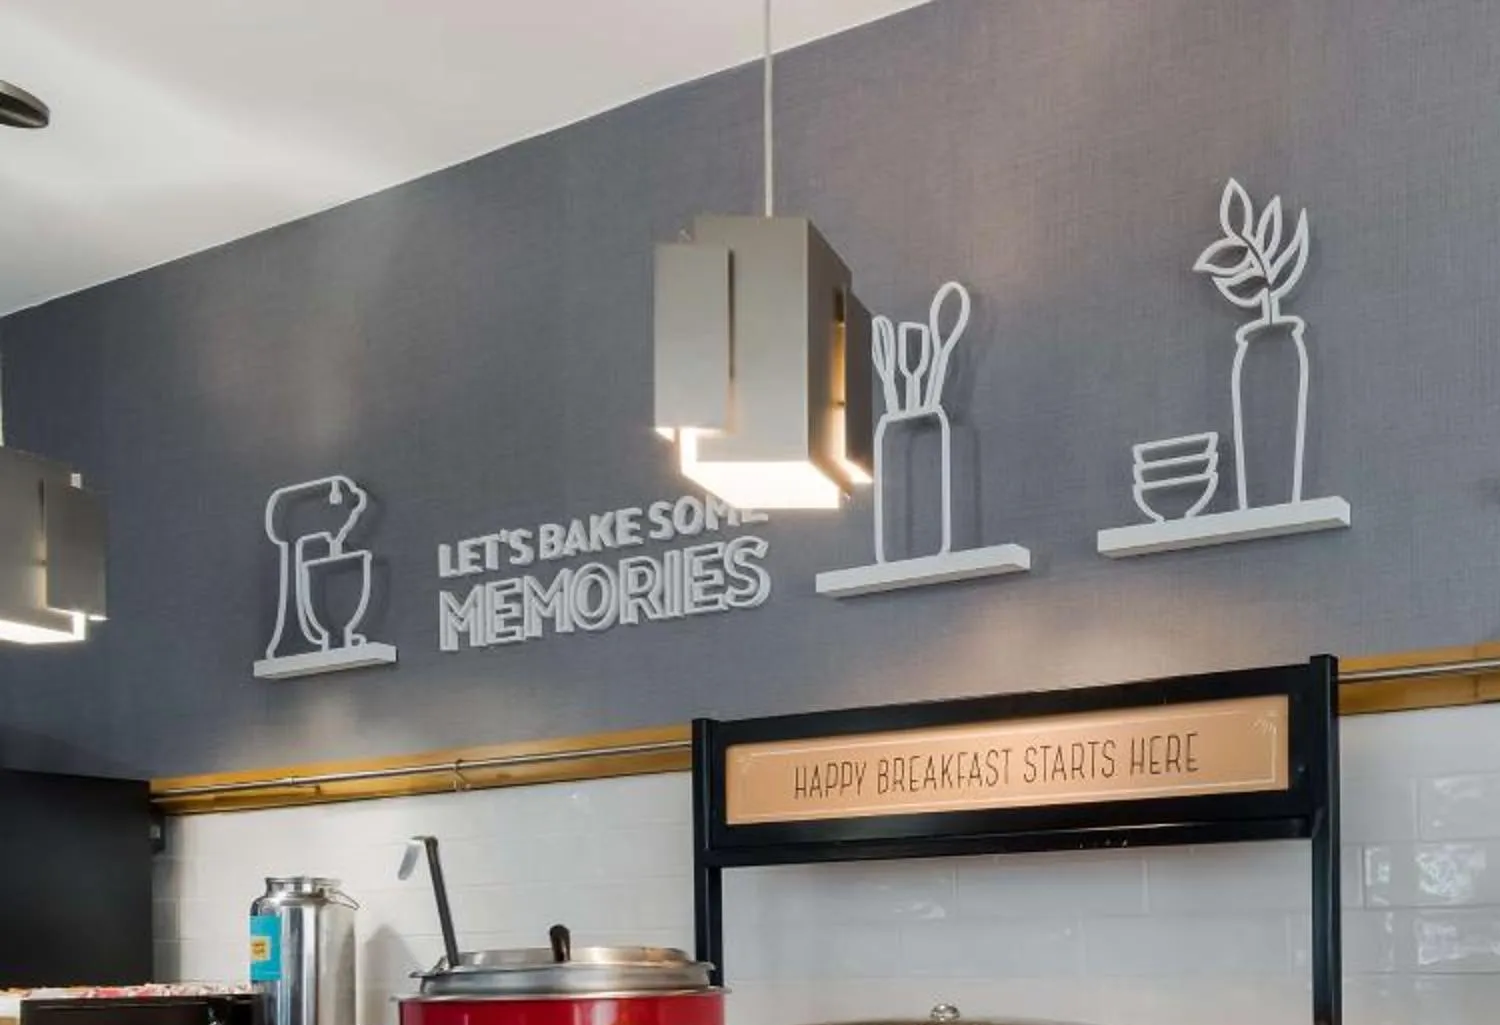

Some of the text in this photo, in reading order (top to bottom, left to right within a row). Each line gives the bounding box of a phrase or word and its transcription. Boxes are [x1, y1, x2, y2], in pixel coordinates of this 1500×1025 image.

[438, 527, 533, 577] LET'S
[540, 507, 644, 560] BAKE
[438, 535, 772, 651] MEMORIES
[794, 732, 1200, 800] HAPPY BREAKFAST STARTS HERE
